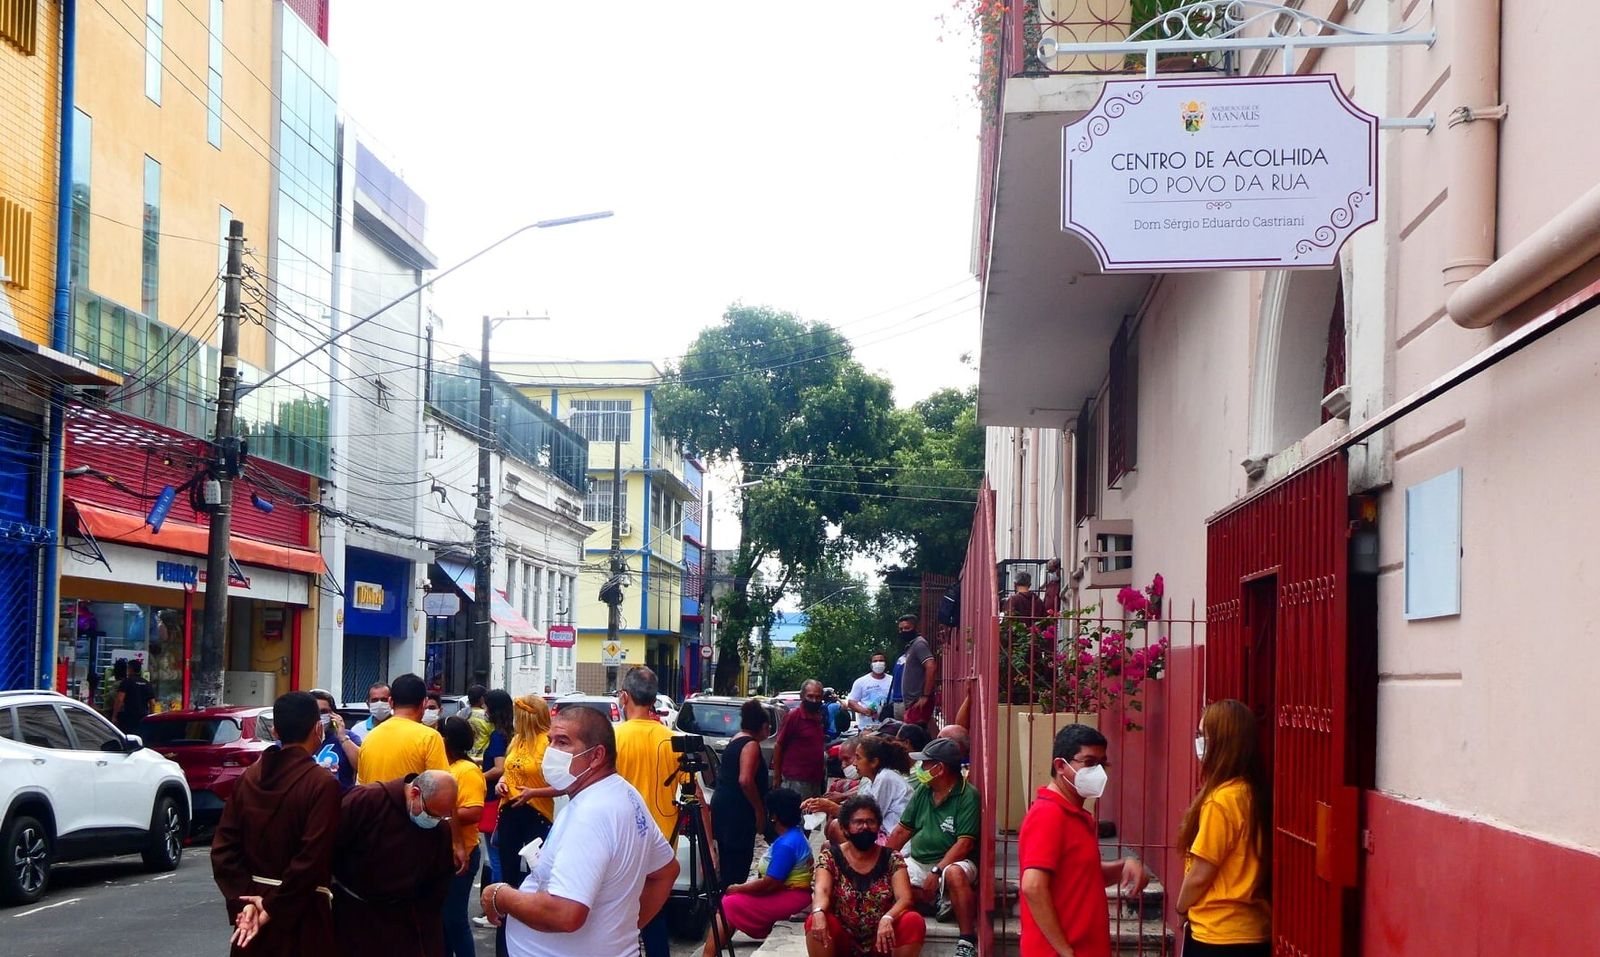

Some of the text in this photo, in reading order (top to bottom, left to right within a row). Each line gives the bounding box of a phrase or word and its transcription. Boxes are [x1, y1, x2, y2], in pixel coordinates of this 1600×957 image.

[1211, 111, 1260, 121] MANAUS
[1111, 147, 1329, 171] CENTRO DE ACOLHIDA
[1129, 173, 1310, 195] DO POVO DA RUA
[1134, 215, 1305, 231] Dom Sérgio Eduardo Castriani
